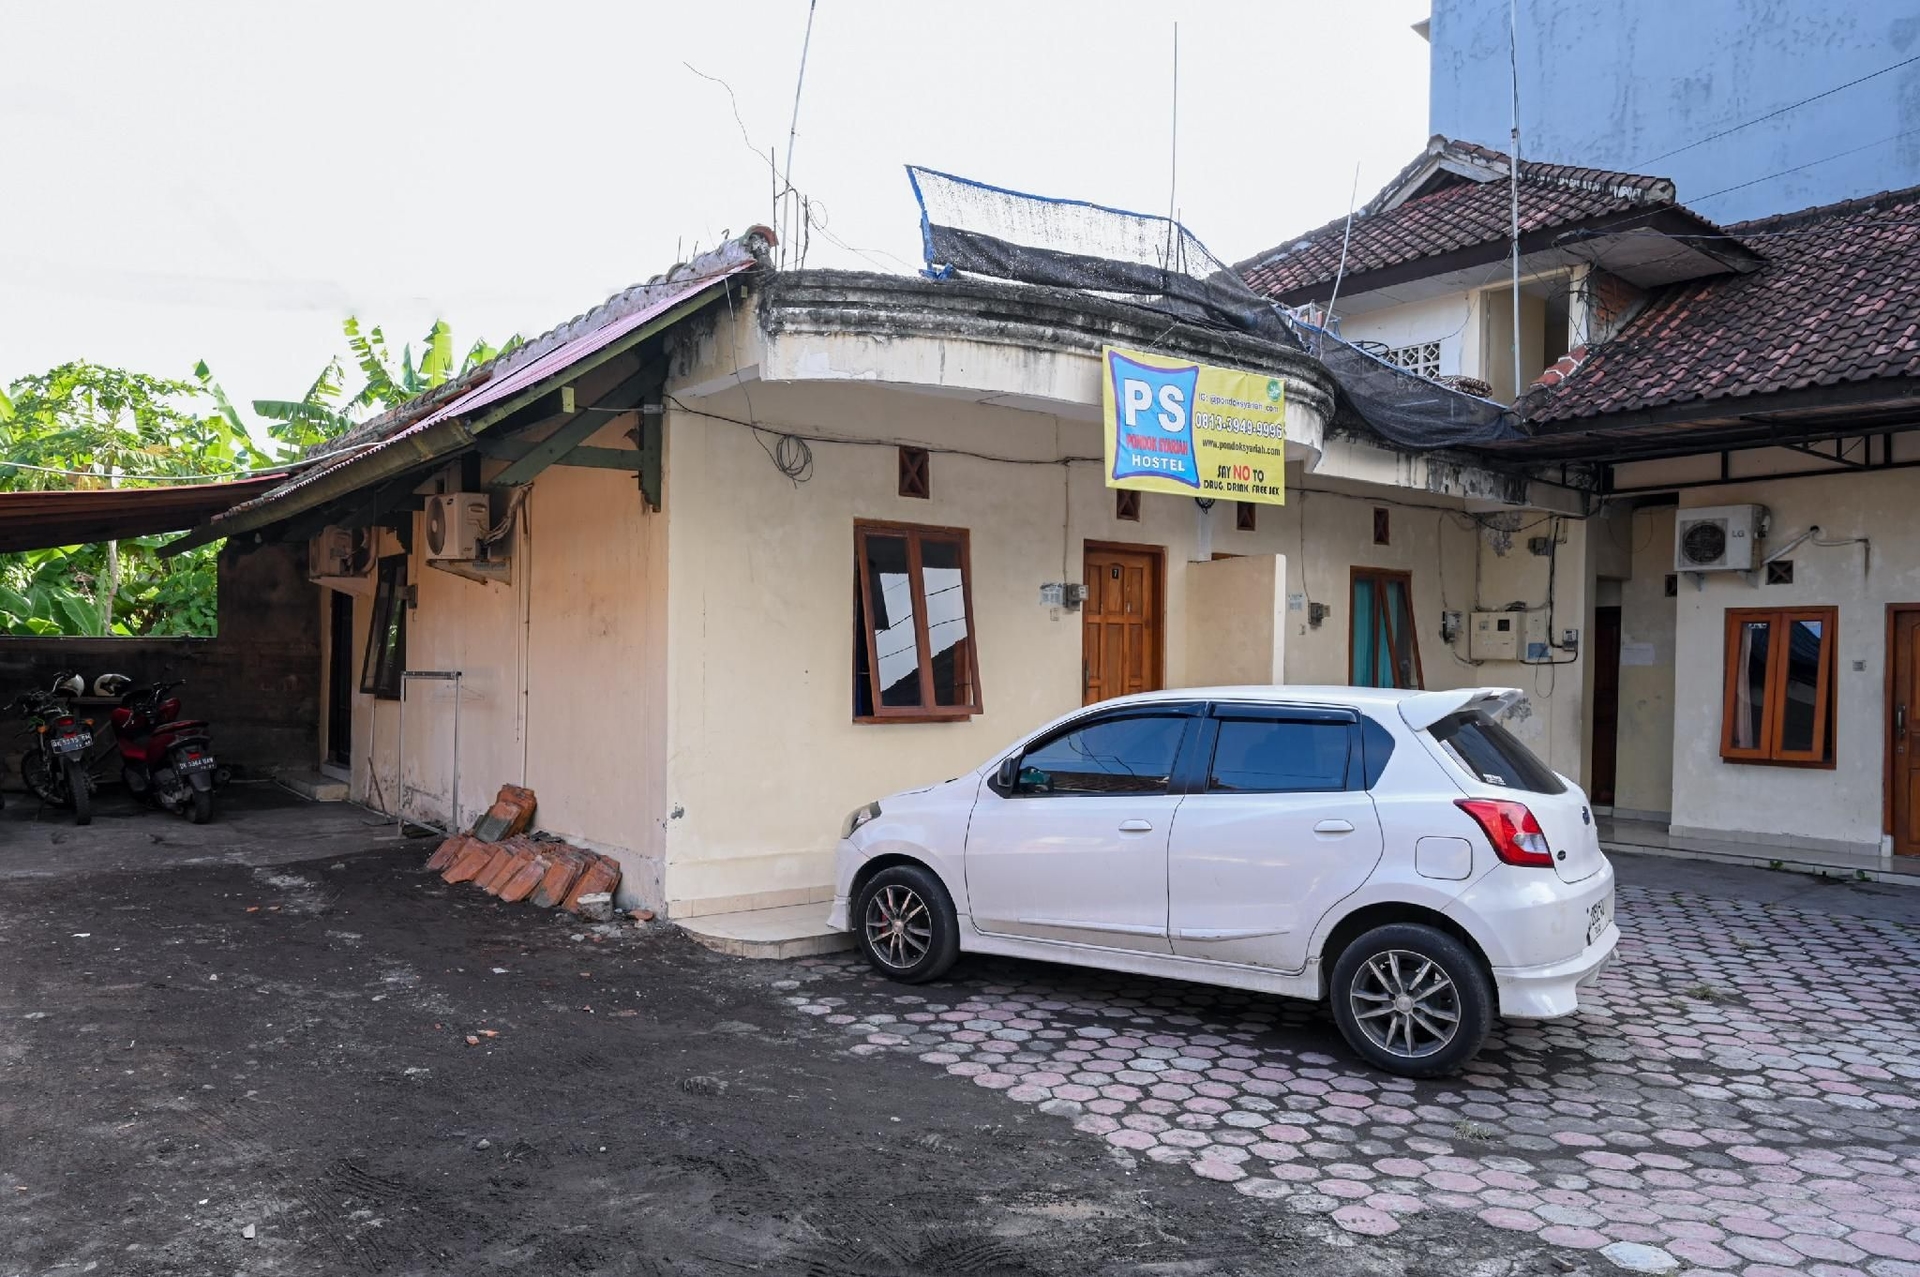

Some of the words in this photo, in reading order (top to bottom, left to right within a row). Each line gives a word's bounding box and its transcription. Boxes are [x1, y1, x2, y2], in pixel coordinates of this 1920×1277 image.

[1124, 378, 1187, 433] PS
[1126, 433, 1158, 451] PONDOK
[1158, 437, 1189, 456] SYARIAH
[1202, 438, 1281, 456] www.pondoksyariah.com
[1132, 453, 1186, 473] HOSTEL
[1217, 465, 1231, 479] SAY
[1233, 464, 1251, 482] NO
[1252, 470, 1264, 482] TO
[1251, 485, 1267, 495] FREE
[1268, 487, 1280, 496] SEX
[1732, 530, 1744, 538] LG
